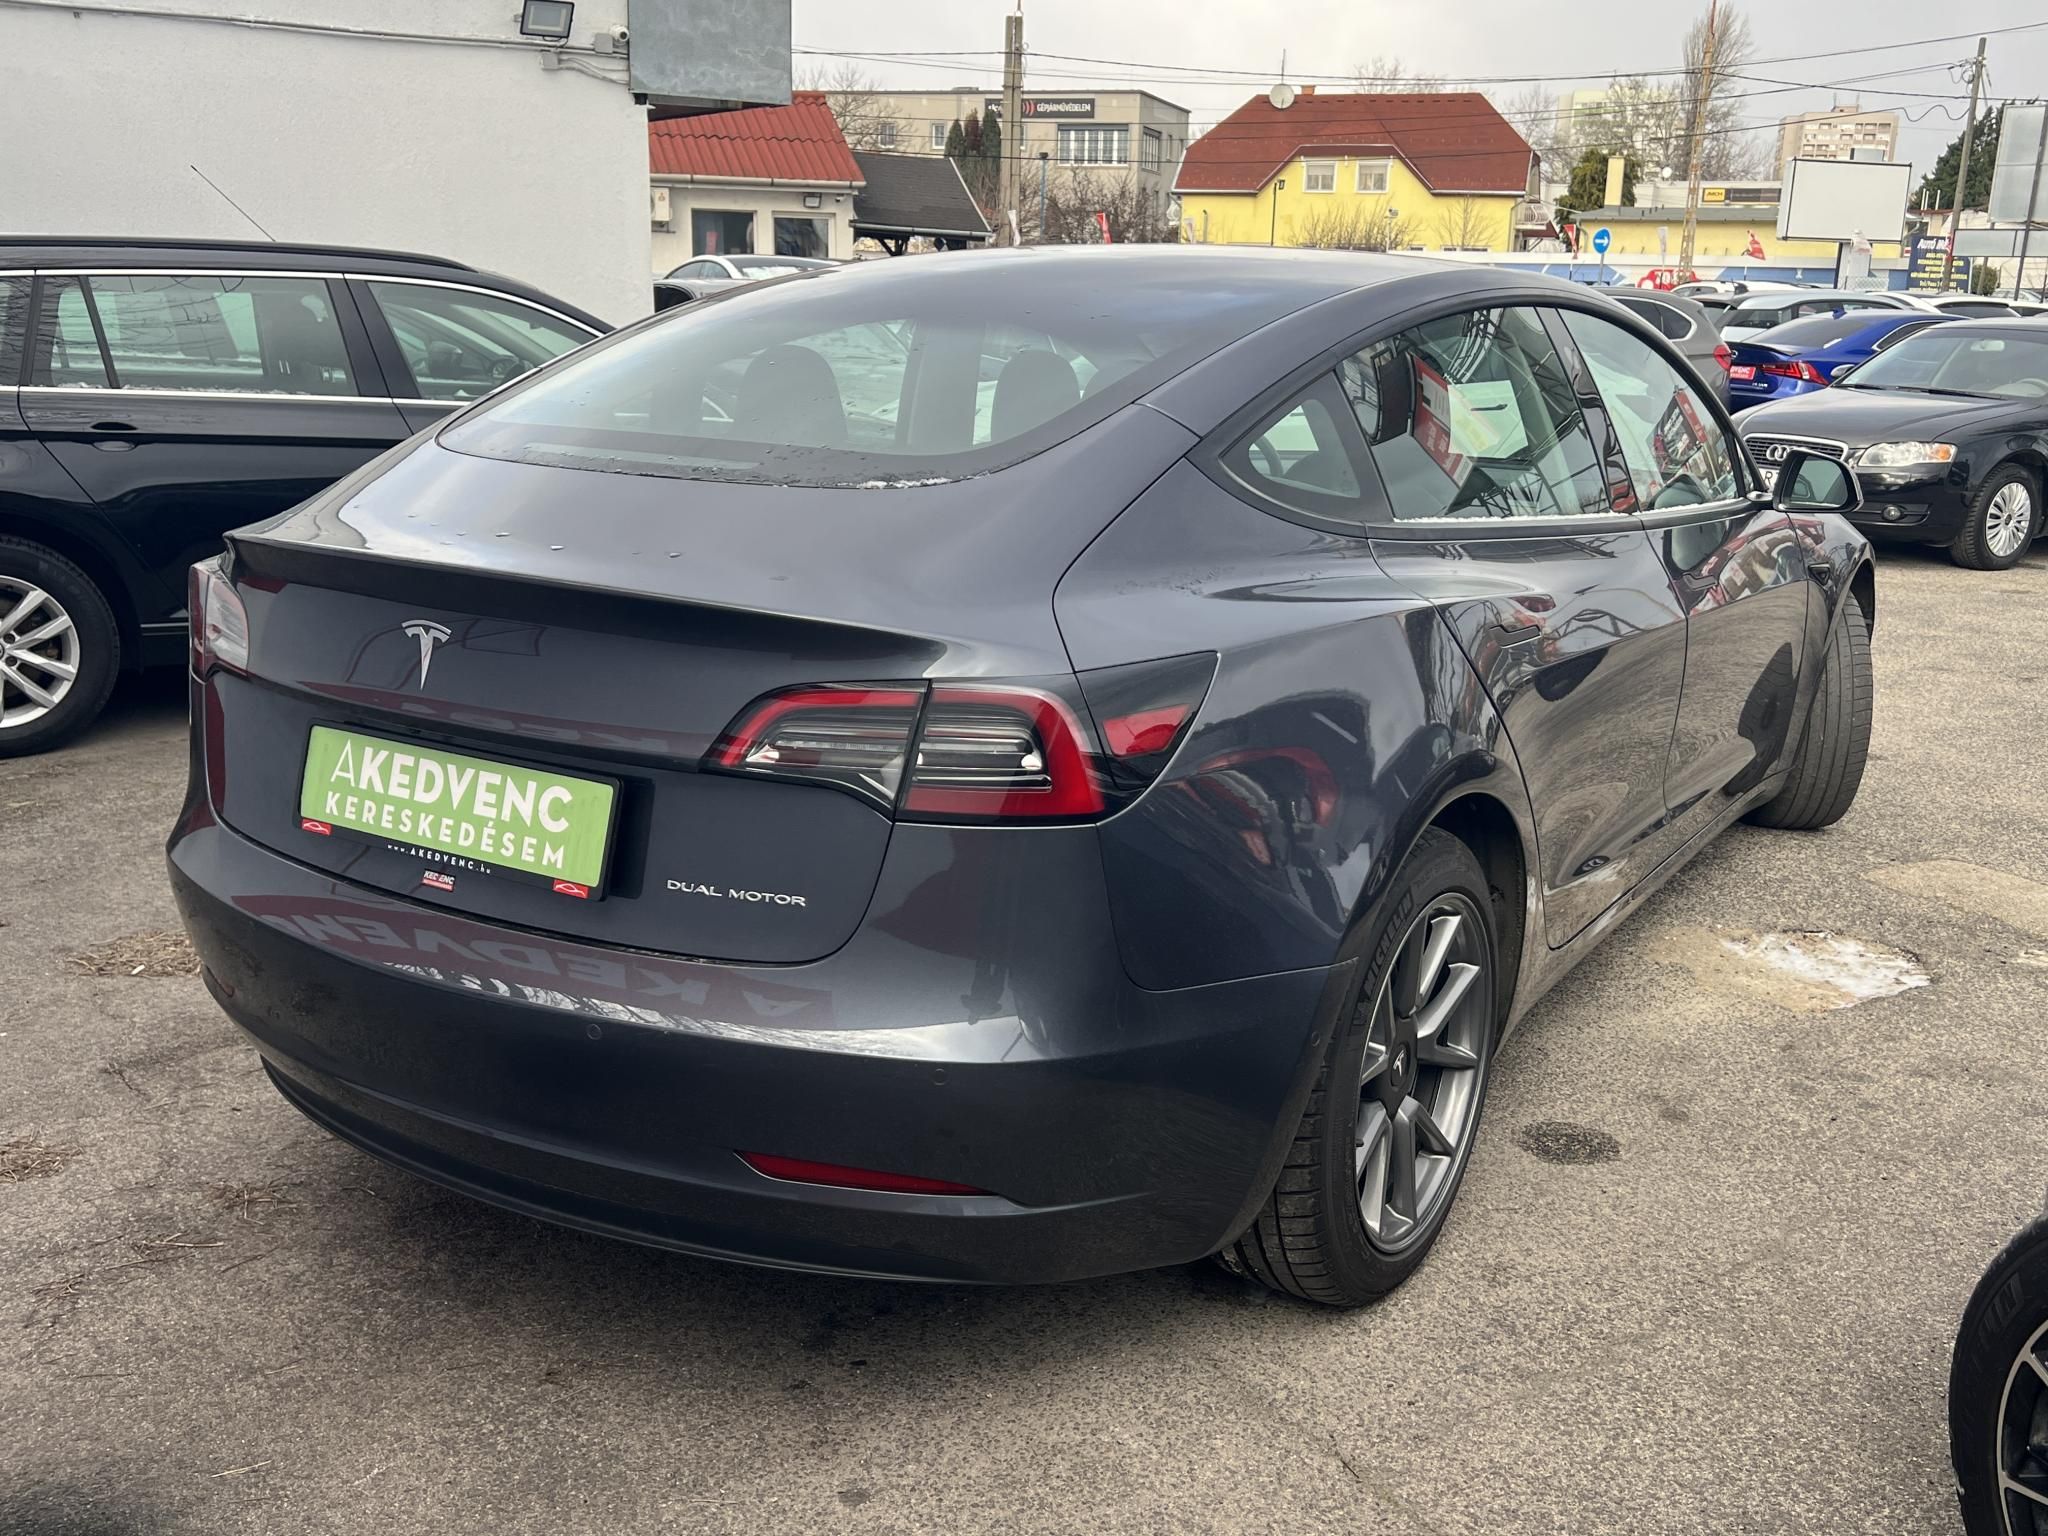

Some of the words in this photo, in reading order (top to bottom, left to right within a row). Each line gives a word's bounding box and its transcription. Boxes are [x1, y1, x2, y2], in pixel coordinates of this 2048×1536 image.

[325, 790, 565, 870] KERESKEDÉSEM
[387, 844, 491, 874] www.AKEDVENC.hu
[667, 879, 723, 897] DUAL
[728, 888, 806, 907] MOTOR
